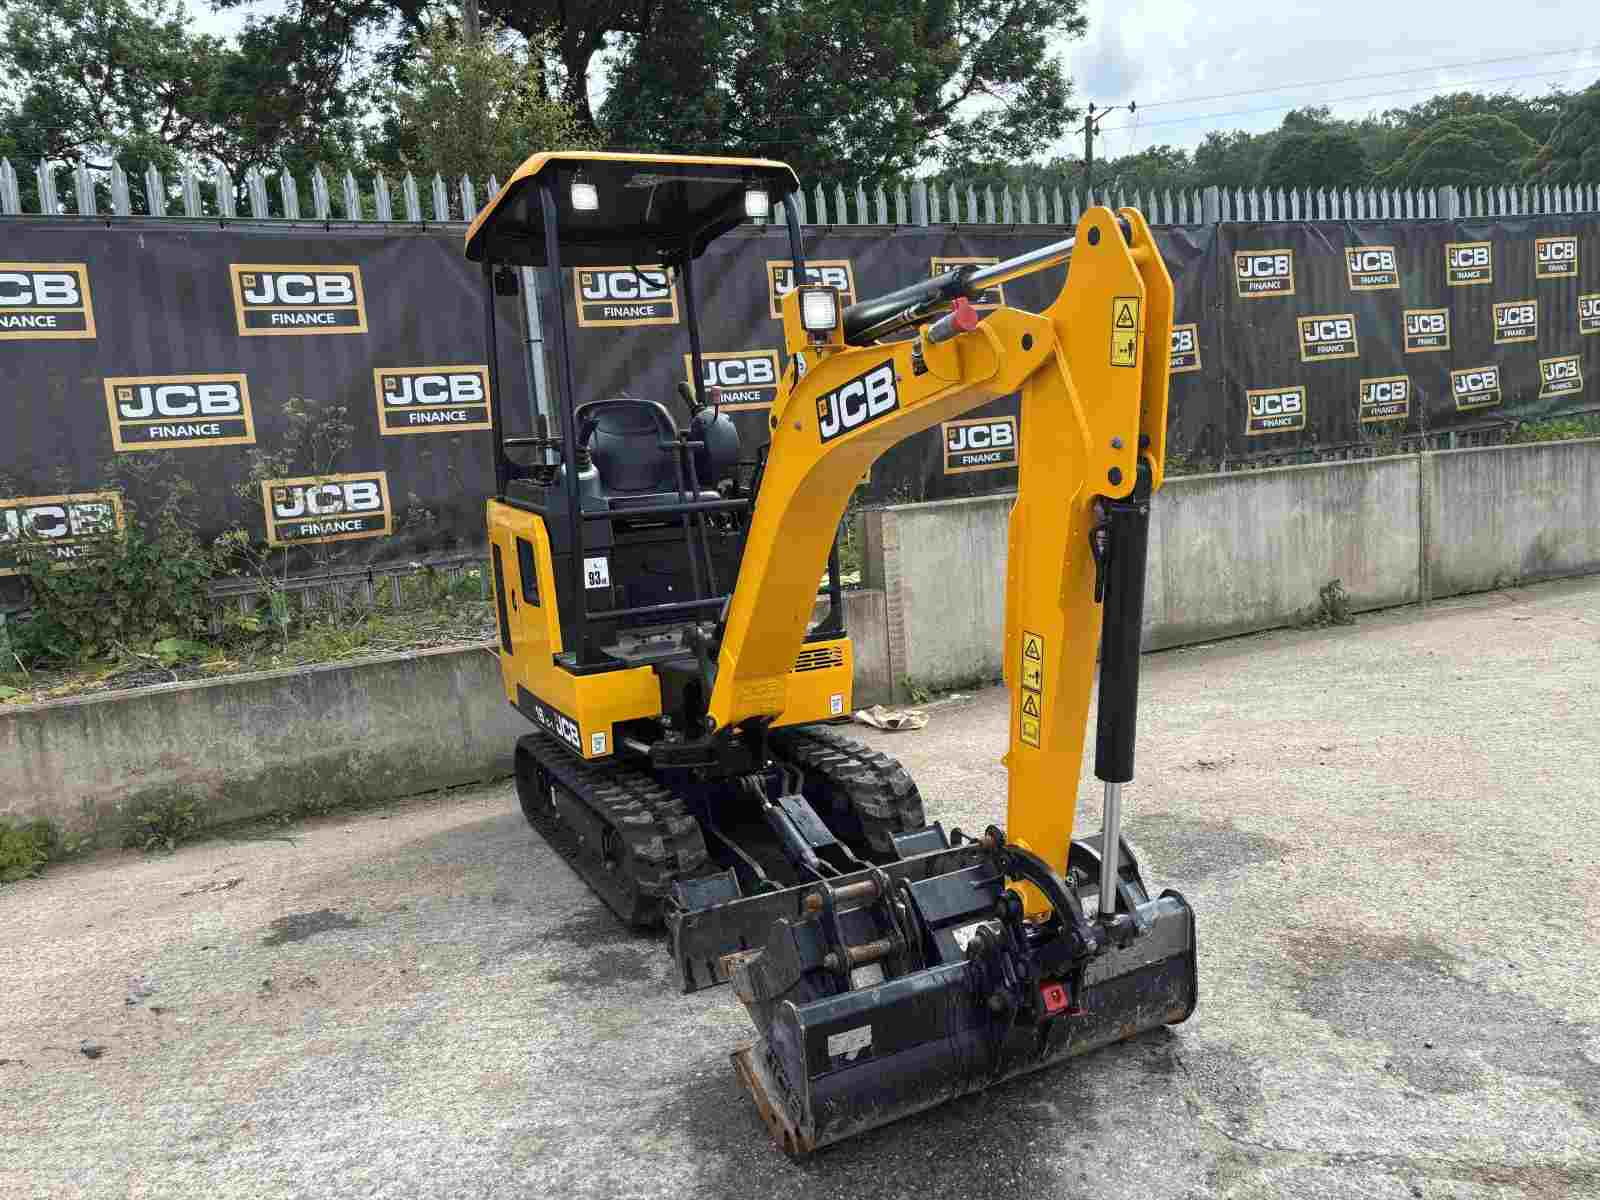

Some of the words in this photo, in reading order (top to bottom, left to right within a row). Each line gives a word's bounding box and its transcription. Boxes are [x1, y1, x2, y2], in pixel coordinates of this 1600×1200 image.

[1451, 247, 1488, 266] JCB
[1539, 241, 1576, 259] JCB
[1239, 256, 1288, 277] JCB
[1350, 251, 1393, 271] JCB
[0, 273, 80, 305] CB
[244, 274, 354, 304] JCB
[582, 271, 669, 298] JCB
[604, 305, 655, 317] FINANCE
[1498, 307, 1534, 325] JCB
[1583, 298, 1600, 317] JC
[0, 315, 57, 328] NANCE
[271, 312, 336, 325] FINANCE
[1408, 315, 1445, 333] JCB
[1305, 320, 1352, 340] JCB
[1172, 331, 1193, 352] CB
[703, 359, 774, 386] JCB
[1456, 373, 1496, 392] JCB
[385, 374, 484, 405] JCB
[718, 389, 761, 403] INANCE
[1364, 383, 1406, 403] JCB
[120, 384, 240, 418] JCB
[820, 367, 896, 439] JCB
[1251, 394, 1300, 414] JCB
[409, 410, 466, 424] FINANCE
[150, 423, 220, 437] FINANCE
[949, 422, 1014, 450] JCB
[962, 452, 1001, 464] FINANCE
[276, 481, 380, 517] JCB
[300, 519, 362, 536] FINANCE
